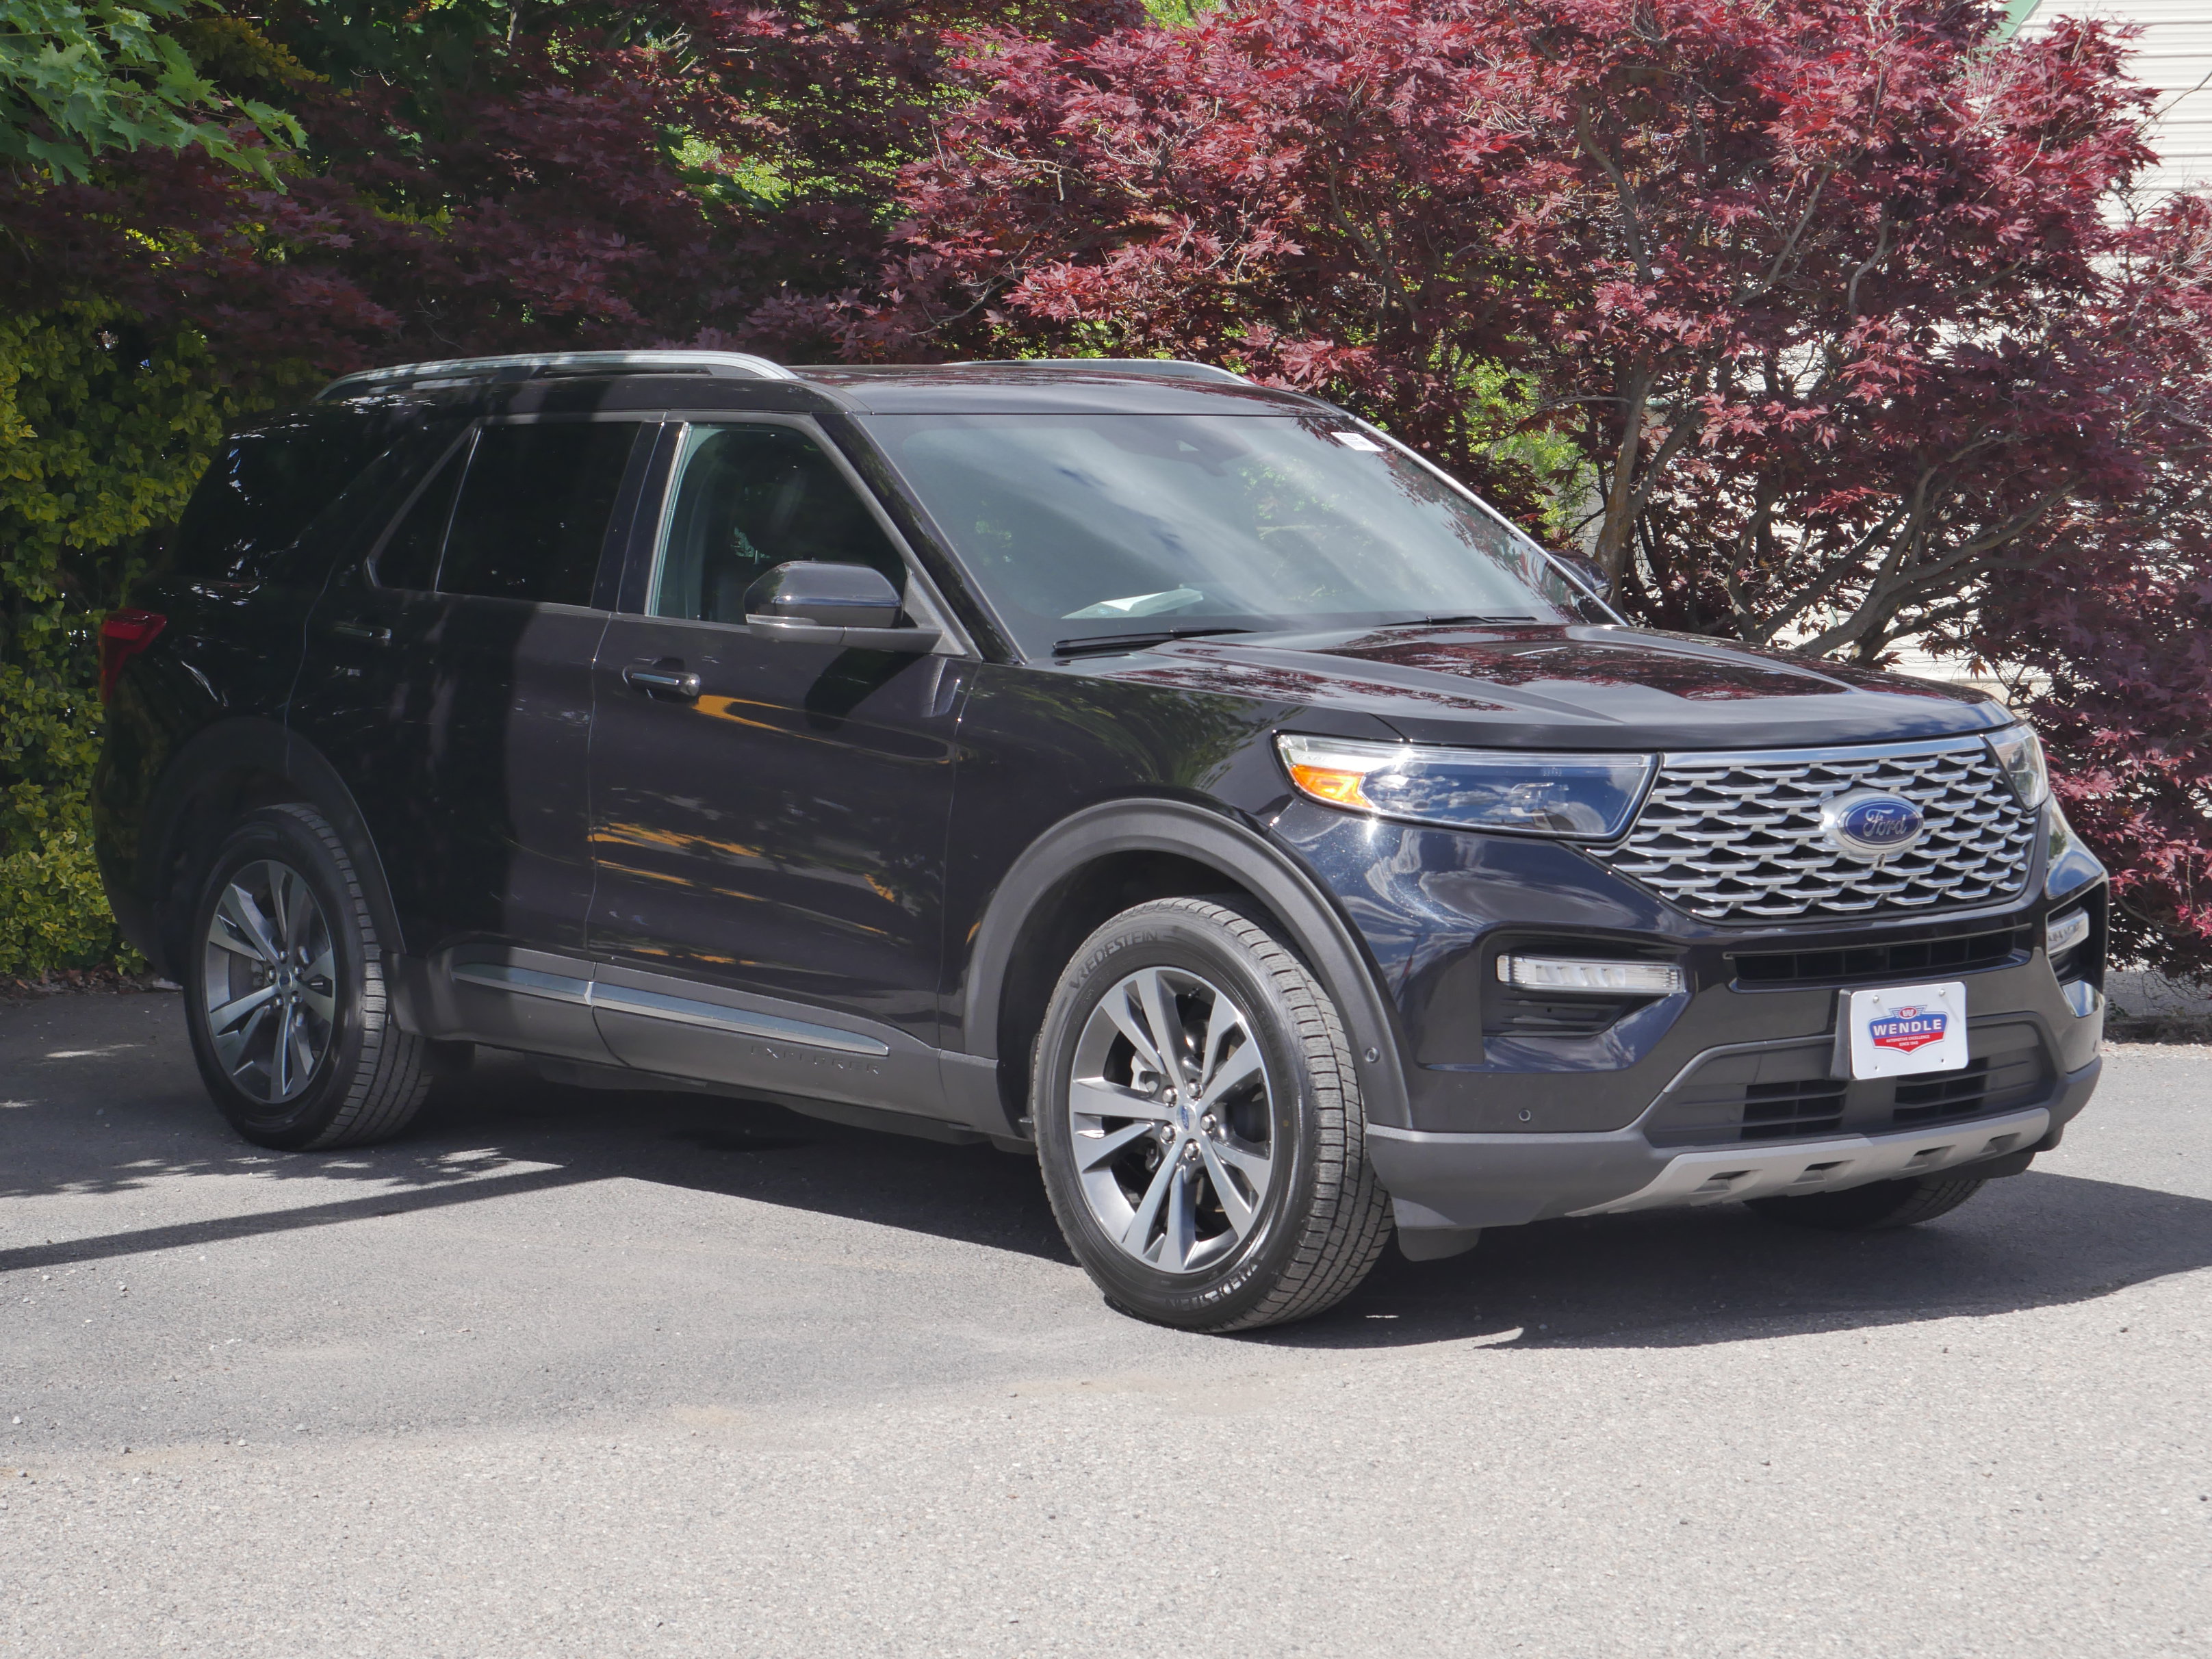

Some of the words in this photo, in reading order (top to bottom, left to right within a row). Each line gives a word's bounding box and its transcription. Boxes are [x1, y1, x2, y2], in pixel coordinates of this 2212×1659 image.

[1863, 808, 1907, 837] Ford
[1068, 930, 1159, 990] VREDESTEIN
[1873, 1018, 1942, 1036] WENDLE
[751, 1044, 879, 1075] EXPLORER
